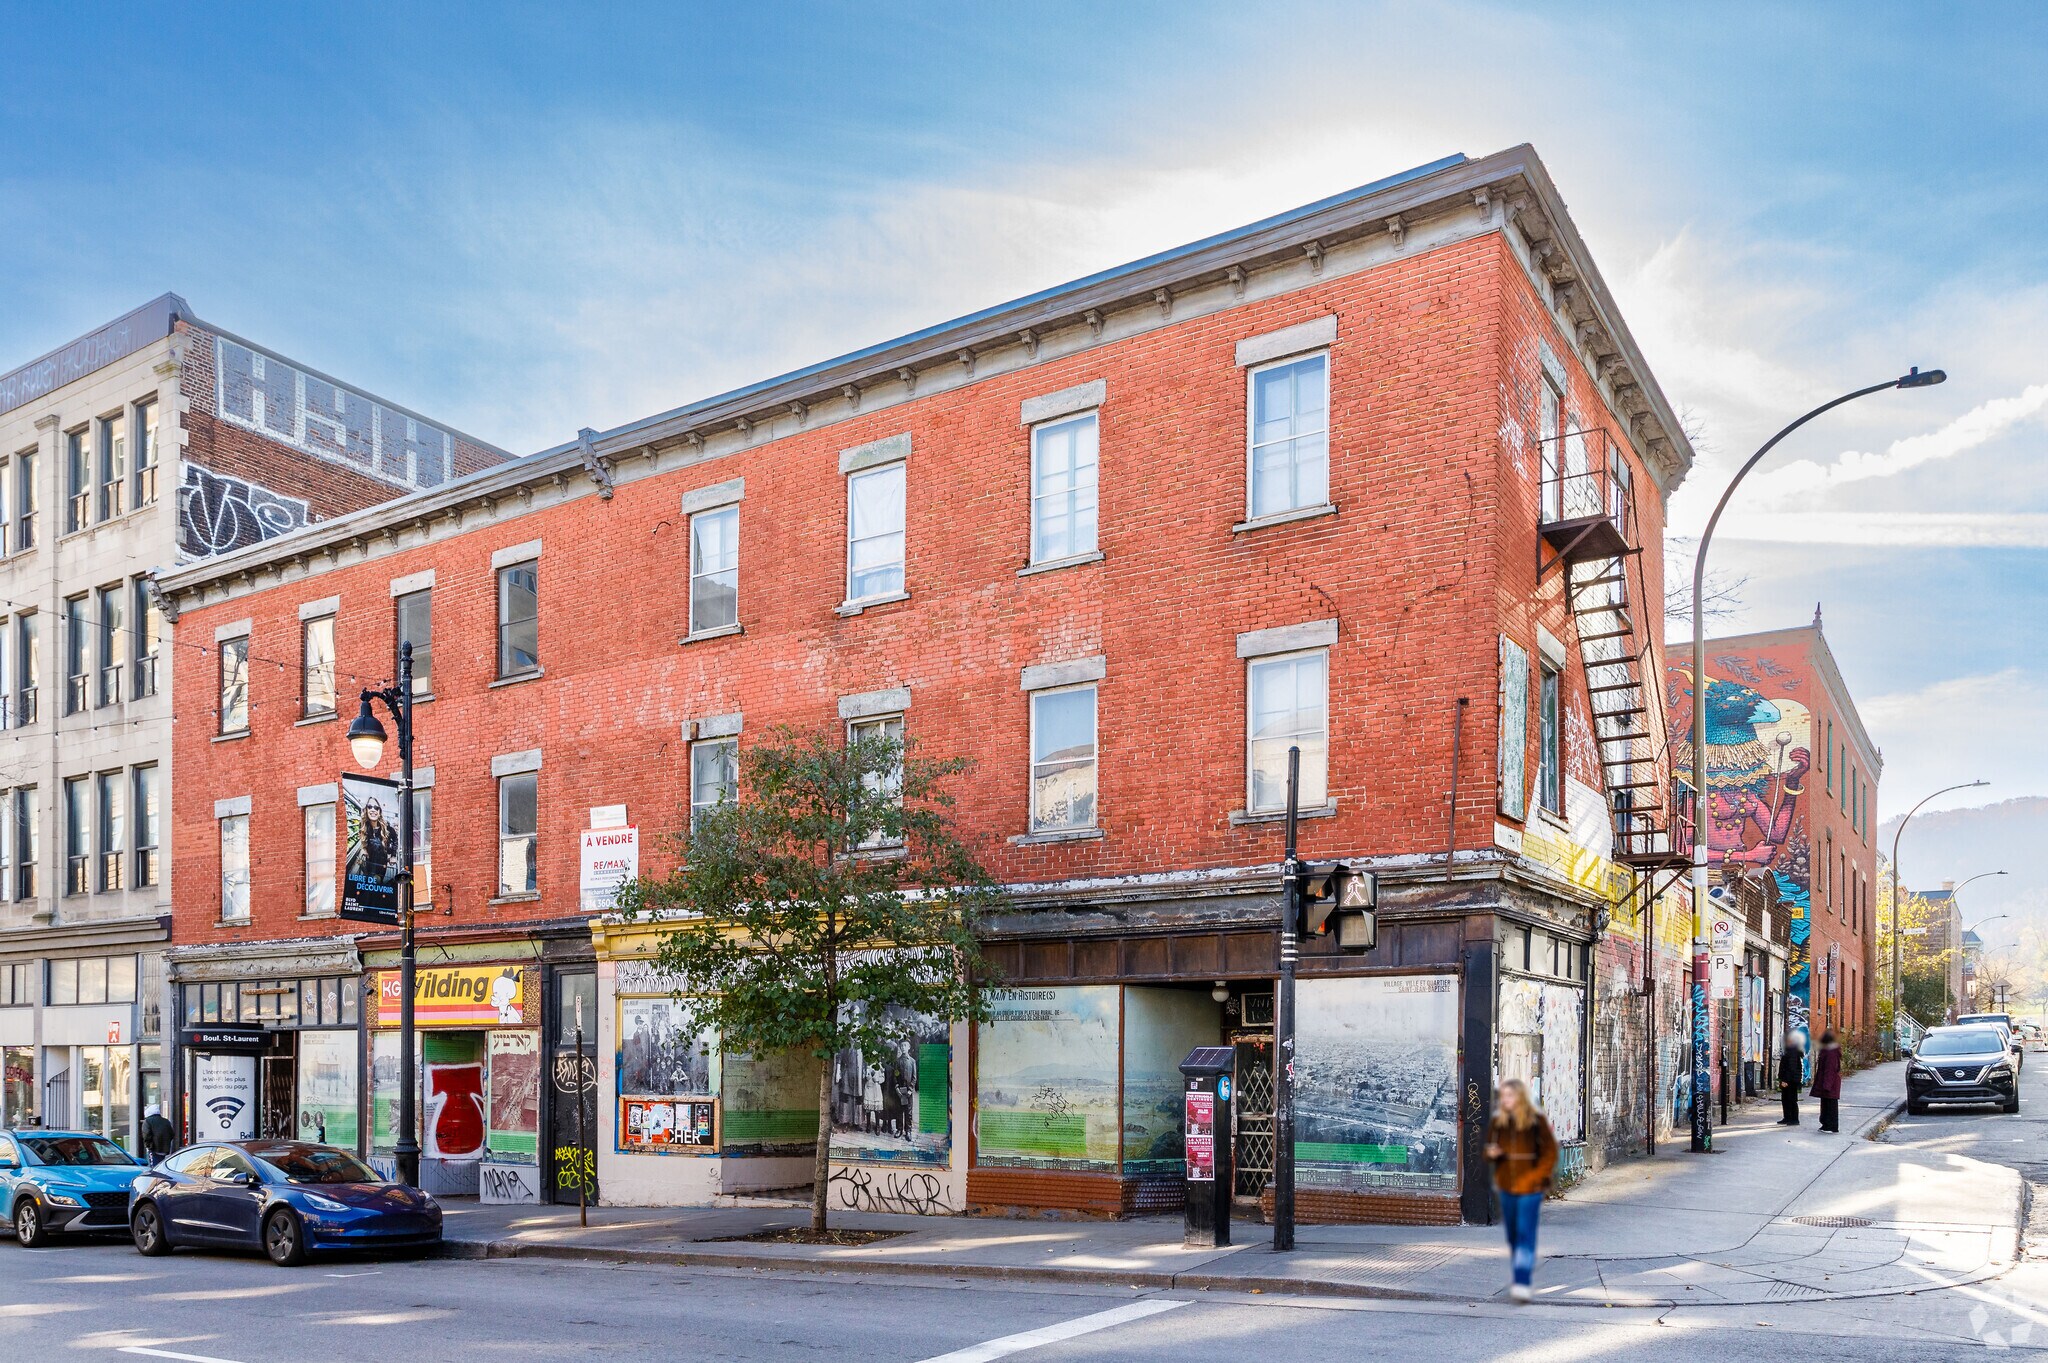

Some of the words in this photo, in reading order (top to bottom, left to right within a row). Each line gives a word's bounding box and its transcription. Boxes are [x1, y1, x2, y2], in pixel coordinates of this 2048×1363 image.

[586, 835, 593, 847] À
[596, 833, 633, 846] VENDRE
[593, 860, 625, 870] RE/MAX
[348, 873, 366, 883] LIBRE
[367, 876, 377, 884] DE
[356, 882, 394, 894] DÉCOUVRIR
[1398, 985, 1451, 993] SAINT-JEAN-BAPTISTE
[989, 990, 1007, 1001] MAIN
[1008, 991, 1017, 1001] EN
[1018, 990, 1056, 1001] HISTOIRE(S)
[203, 1034, 221, 1042] Boul.
[223, 1034, 260, 1043] St-Laurent
[240, 1131, 254, 1140] Bell
